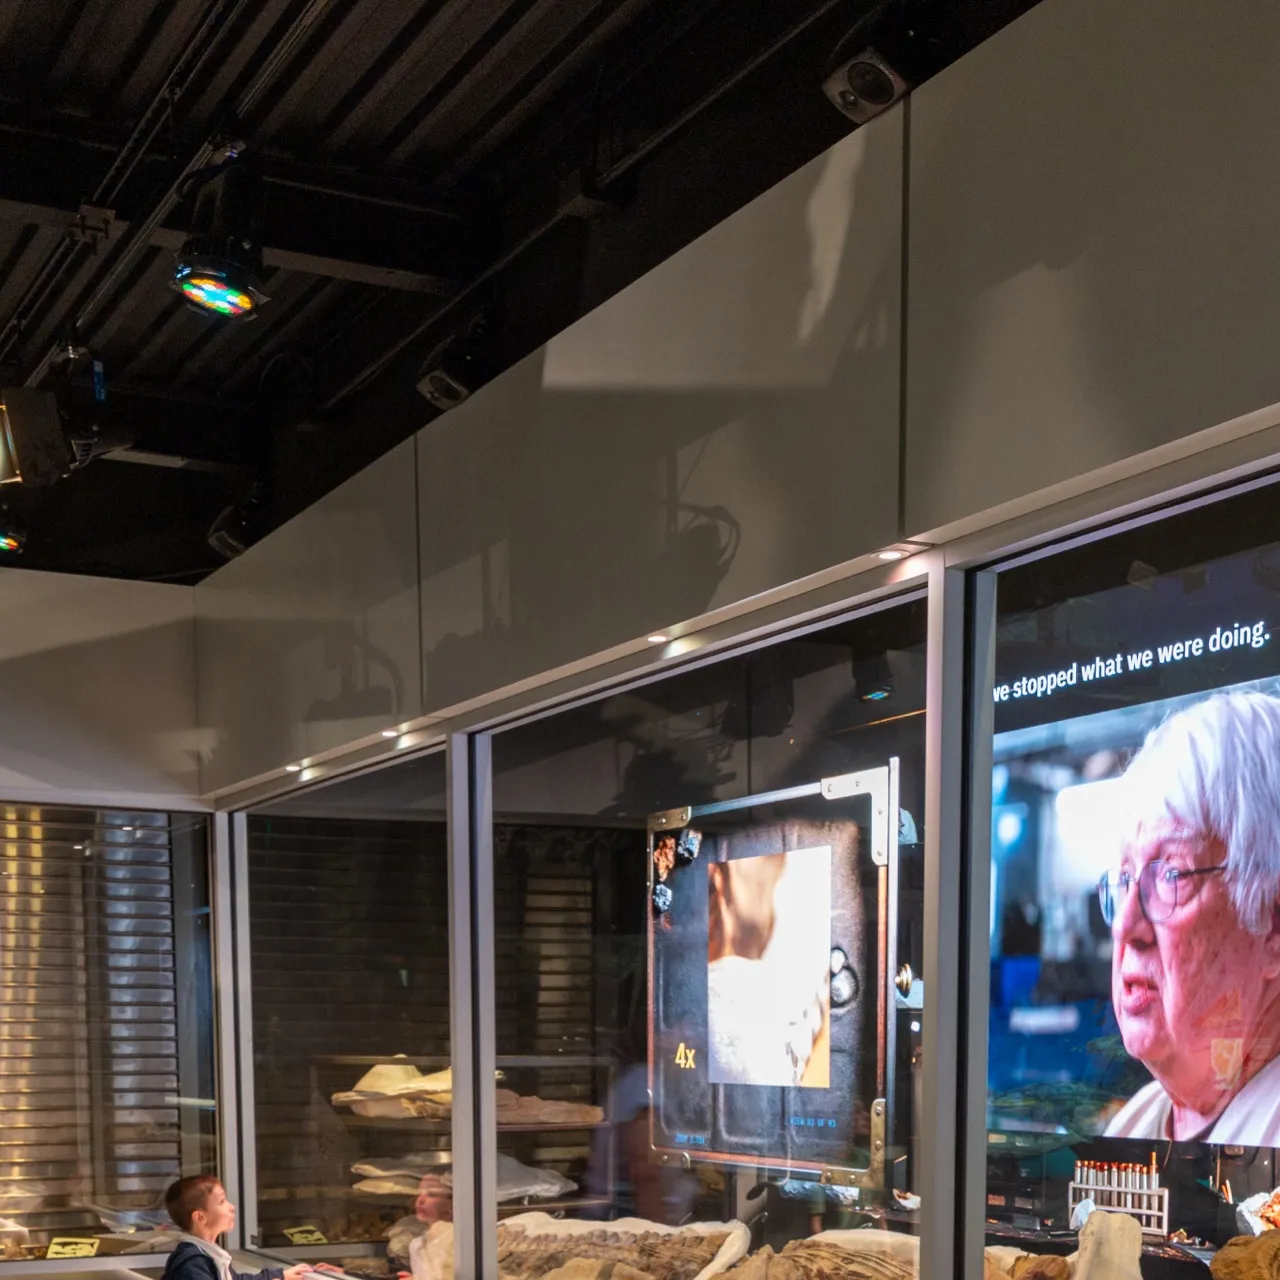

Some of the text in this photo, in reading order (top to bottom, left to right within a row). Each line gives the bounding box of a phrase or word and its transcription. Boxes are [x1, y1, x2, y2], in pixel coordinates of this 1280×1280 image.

[1013, 663, 1077, 697] stopped
[1081, 653, 1123, 682] what
[1127, 649, 1153, 672] we
[1158, 637, 1204, 664] were
[1208, 621, 1271, 652] doing.
[675, 1042, 696, 1068] 4x
